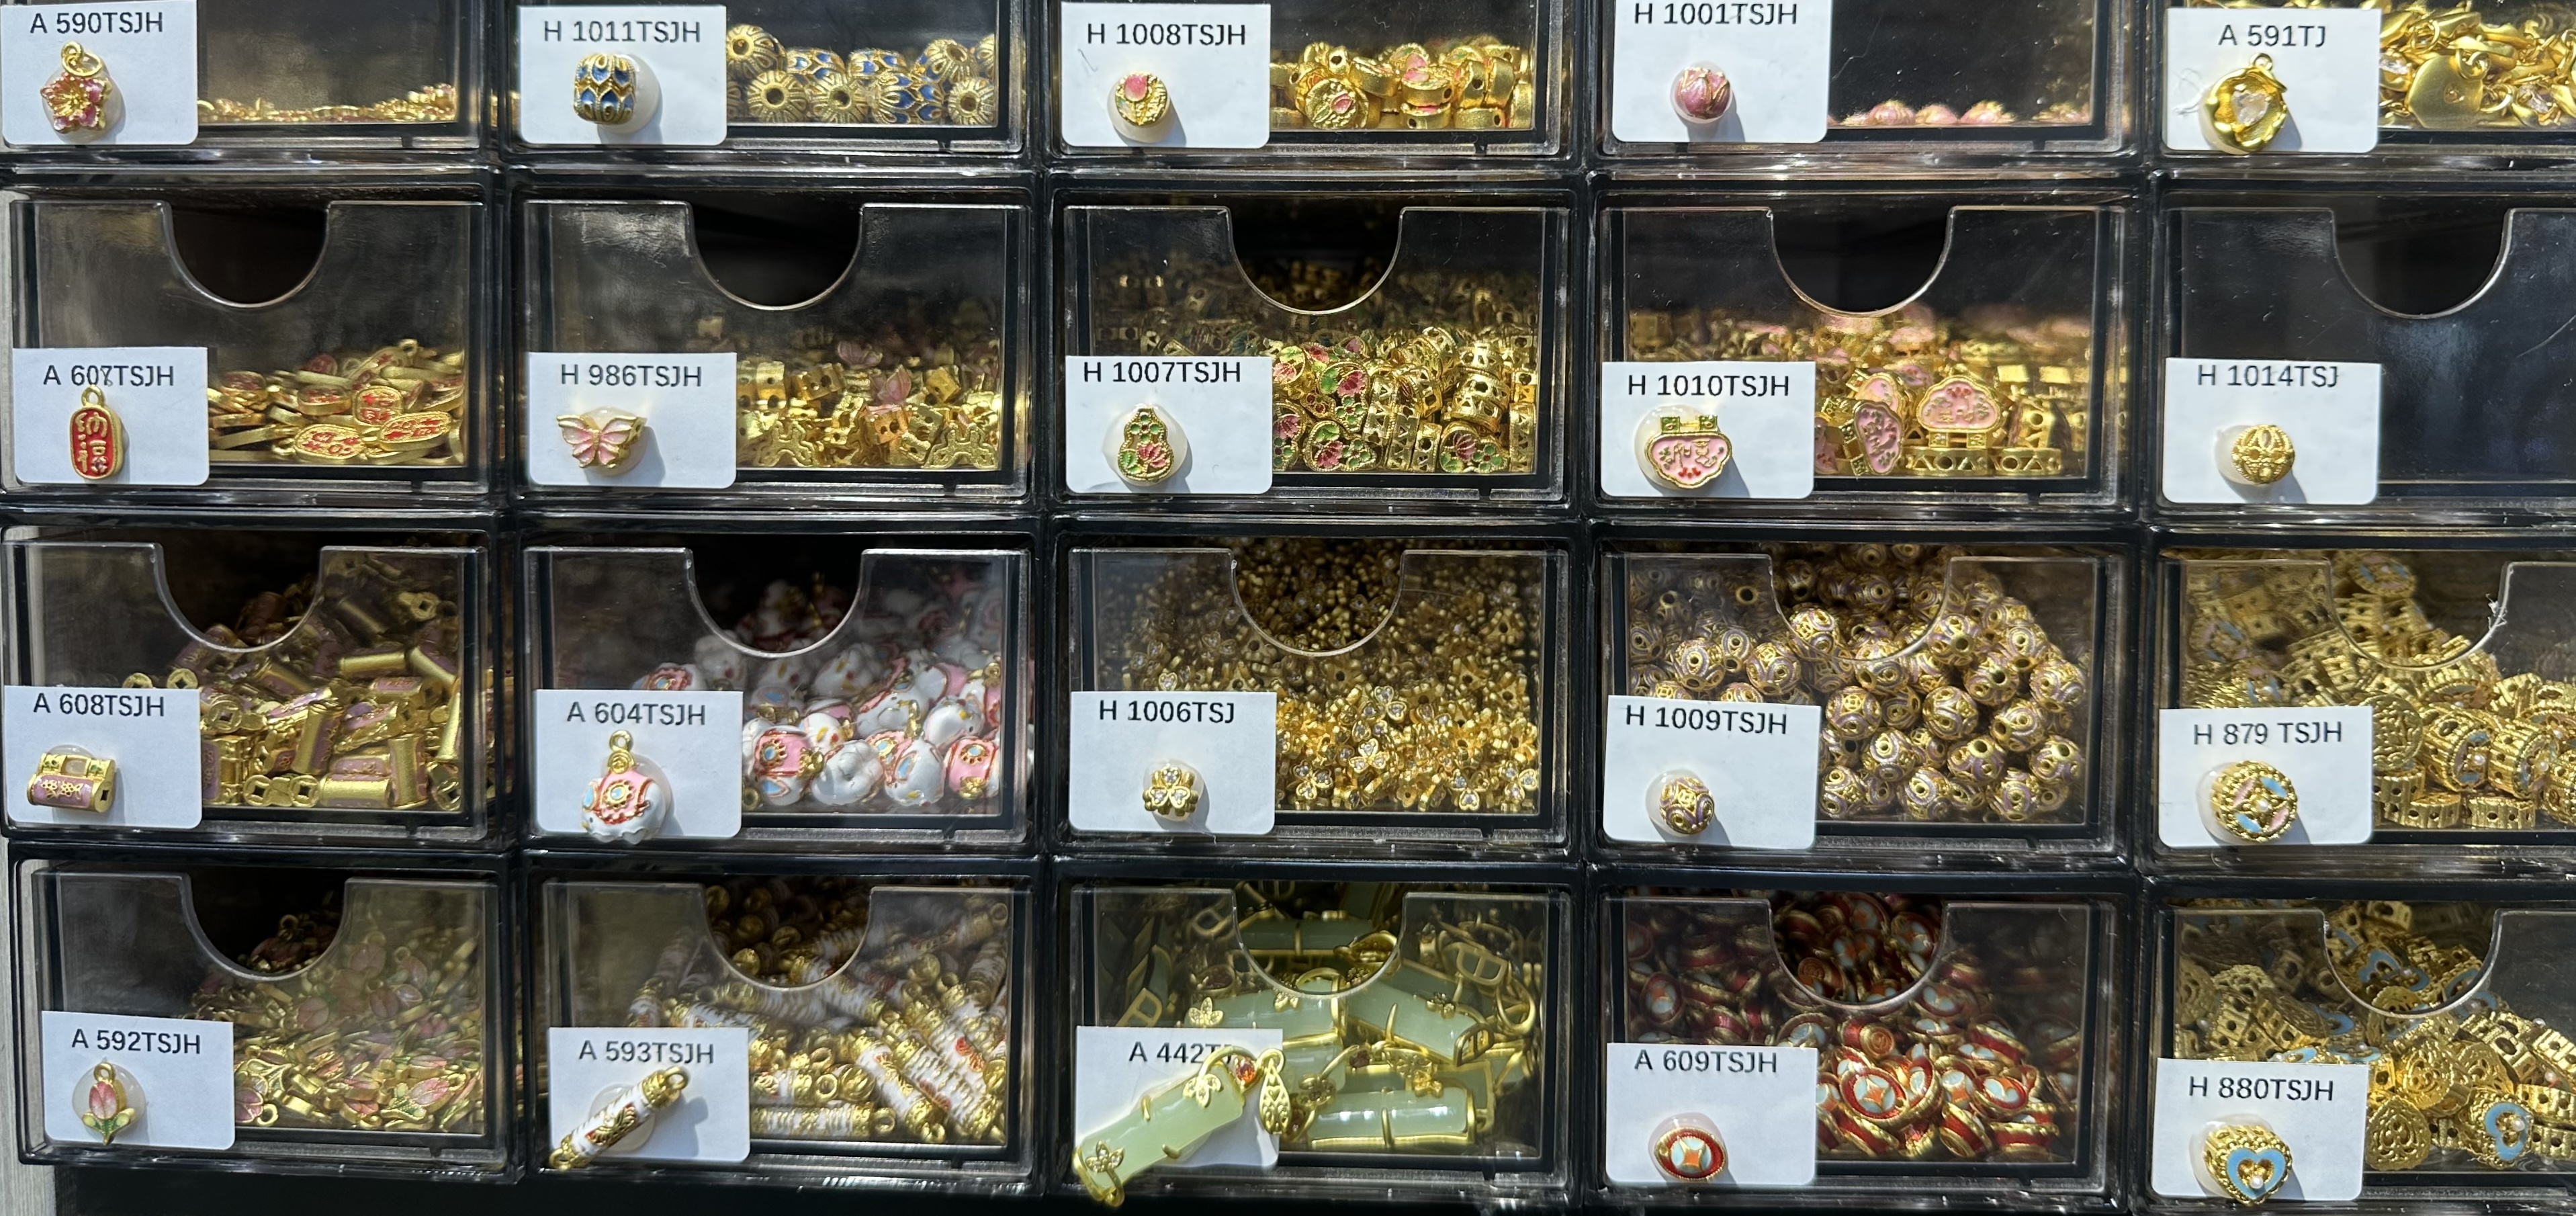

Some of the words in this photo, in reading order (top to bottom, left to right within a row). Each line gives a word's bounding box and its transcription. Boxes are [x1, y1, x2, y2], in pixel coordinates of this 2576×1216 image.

[30, 13, 48, 34] A
[57, 12, 163, 34] 590TSJH
[1635, 3, 1652, 24] H
[1664, 3, 1797, 25] 1001TSJH
[545, 21, 562, 42] H
[573, 21, 700, 43] 1011TSJH
[1088, 24, 1105, 44] H
[1116, 24, 1245, 46] 1008TSJH
[2218, 25, 2237, 46] A
[2248, 25, 2325, 48] 591TJ
[43, 365, 61, 385] A
[71, 365, 173, 386] 607TSJH
[562, 364, 578, 384] H
[588, 365, 701, 387] 986TSJH
[1084, 362, 1101, 382] H
[1113, 362, 1240, 383] 1007TSJH
[2198, 365, 2216, 386] H
[2227, 365, 2339, 388] 1014TSJ
[1629, 375, 1646, 395] H
[1657, 375, 1789, 397] 1010TSJH
[33, 693, 51, 713] A
[60, 693, 164, 717] 608TSJH
[567, 701, 586, 722] A
[595, 703, 705, 726] 604TSJH
[1100, 700, 1116, 720] H
[1128, 701, 1234, 724] 1006TSJ
[1626, 705, 1644, 726] H
[1655, 707, 1786, 734] 1009TSJH
[2194, 724, 2212, 744] H
[2223, 723, 2268, 745] 879
[2277, 722, 2342, 744] TSJH
[72, 1029, 89, 1048] A
[97, 1030, 200, 1054] 592TSJH
[578, 1040, 597, 1060] A
[606, 1041, 713, 1064] 593TSJH
[1128, 1041, 1147, 1062] A
[1634, 1049, 1653, 1070] A
[1663, 1050, 1776, 1073] 609TSJH
[2189, 1076, 2207, 1096] H
[2218, 1078, 2333, 1101] 880TSJH
